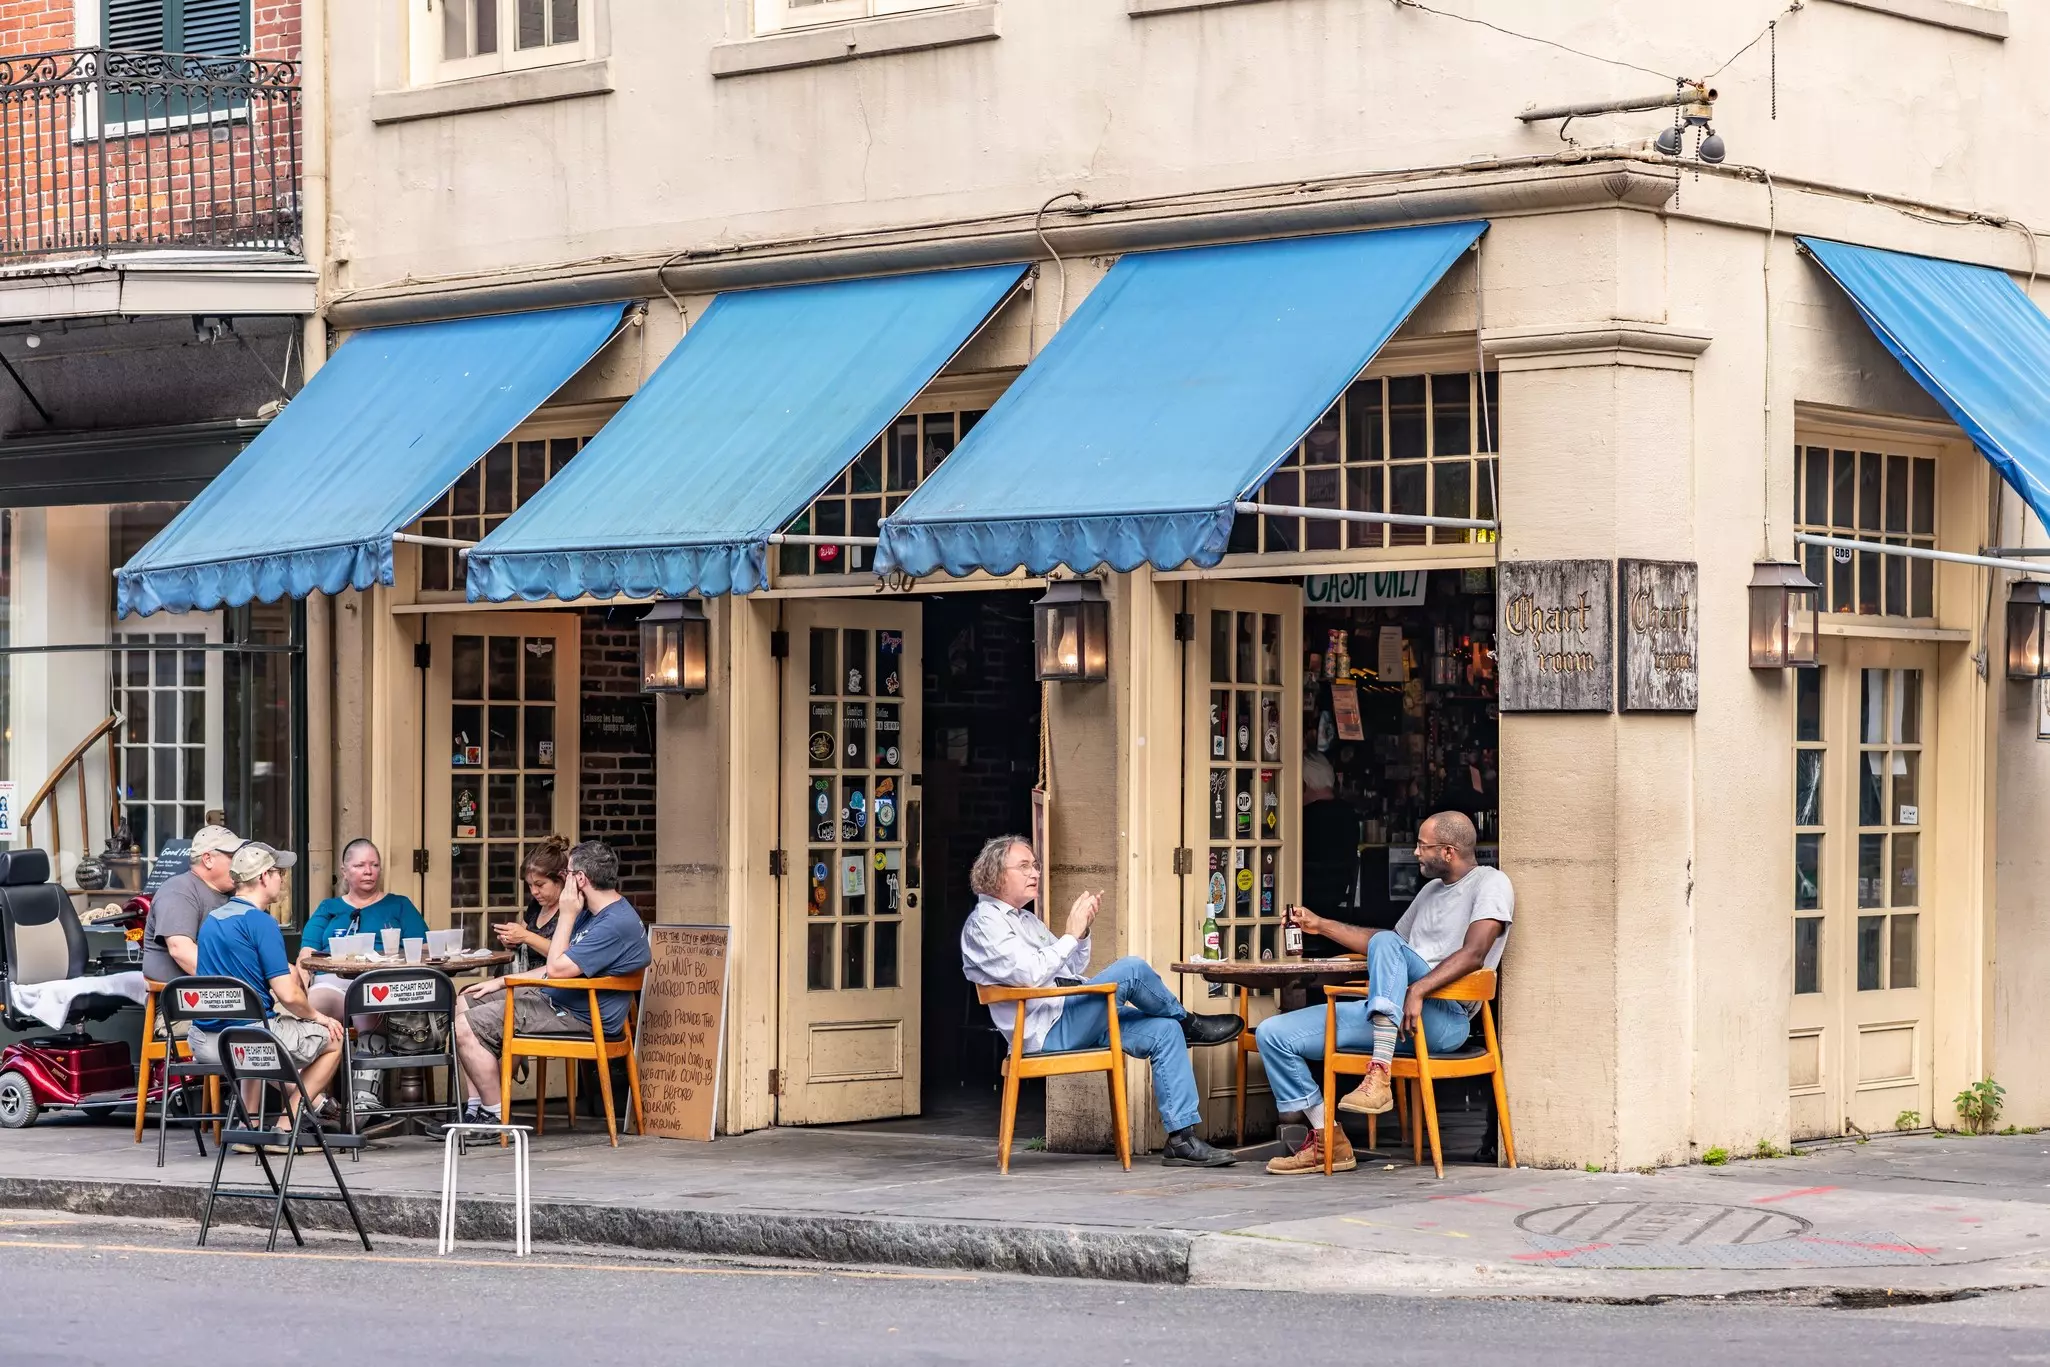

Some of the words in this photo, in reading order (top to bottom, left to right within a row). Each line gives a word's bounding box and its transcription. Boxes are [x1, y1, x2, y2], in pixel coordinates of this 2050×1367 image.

[1835, 548, 1850, 558] BDB
[1505, 590, 1592, 652] Chart
[1631, 590, 1690, 651] Chart
[1538, 651, 1596, 675] room
[1655, 651, 1692, 675] room
[1239, 796, 1250, 807] DIP
[656, 931, 668, 942] PER
[389, 984, 399, 992] THE
[399, 983, 417, 992] CHART
[418, 981, 433, 990] ROOM
[199, 991, 209, 999] THE
[209, 991, 225, 999] CHART
[226, 990, 242, 999] ROOM
